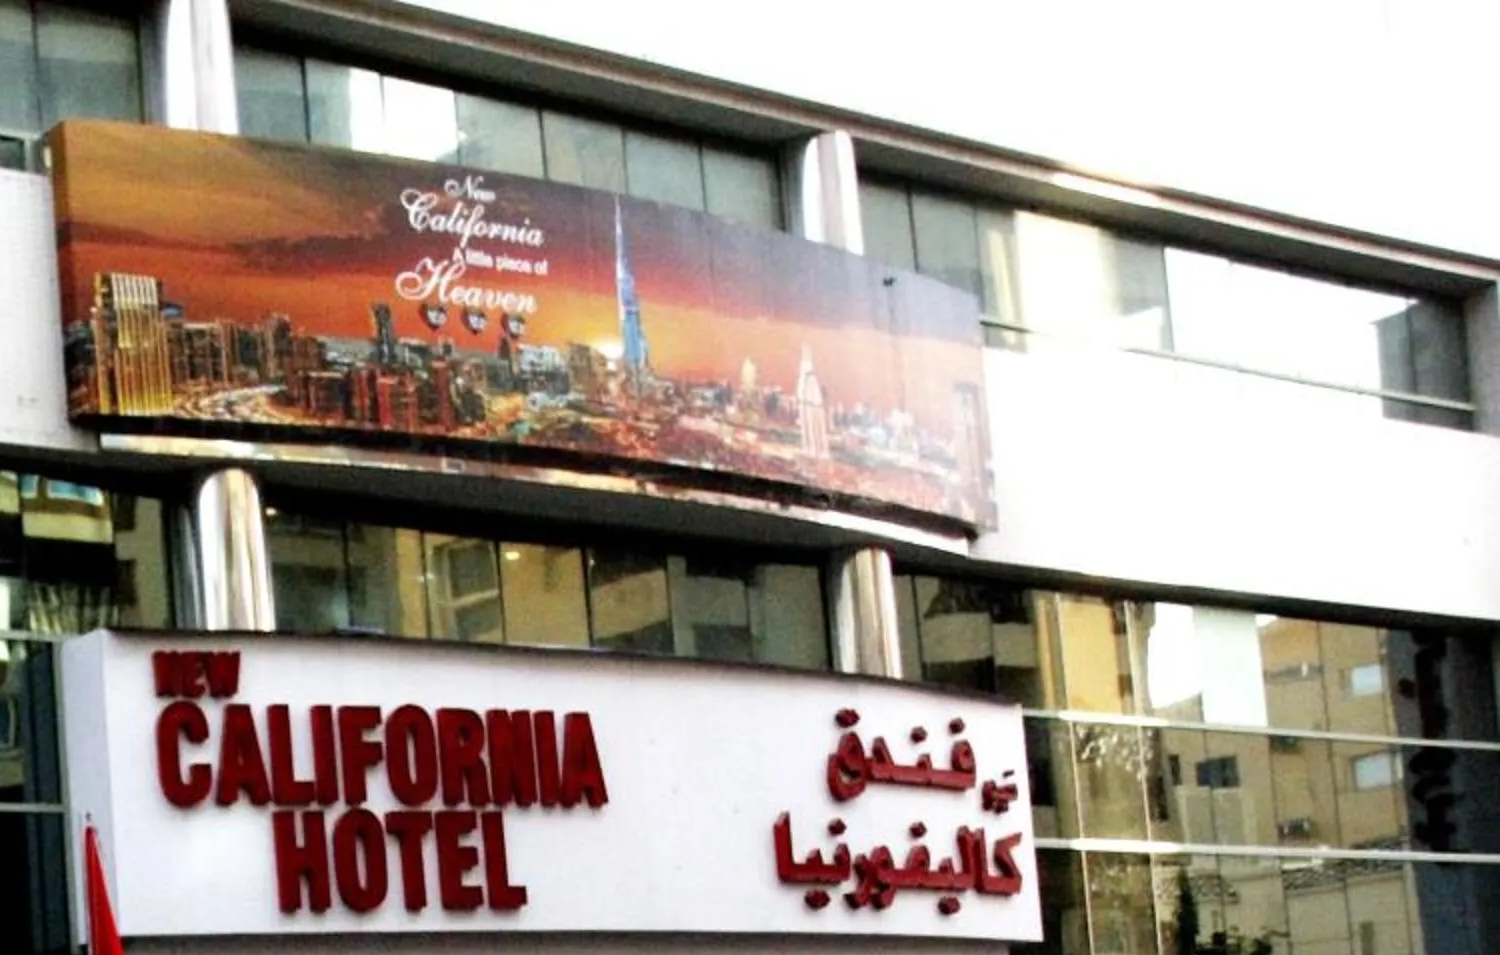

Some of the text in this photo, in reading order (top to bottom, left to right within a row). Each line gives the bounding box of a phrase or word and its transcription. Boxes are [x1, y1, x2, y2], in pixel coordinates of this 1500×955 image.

[401, 189, 544, 248] California
[395, 257, 537, 313] Heaven
[152, 650, 241, 698] NEW
[156, 701, 609, 808] CALIFORNIA
[827, 709, 976, 803] فندق
[272, 808, 527, 913] HOTEL
[773, 811, 1022, 914] كاليفورنيا
